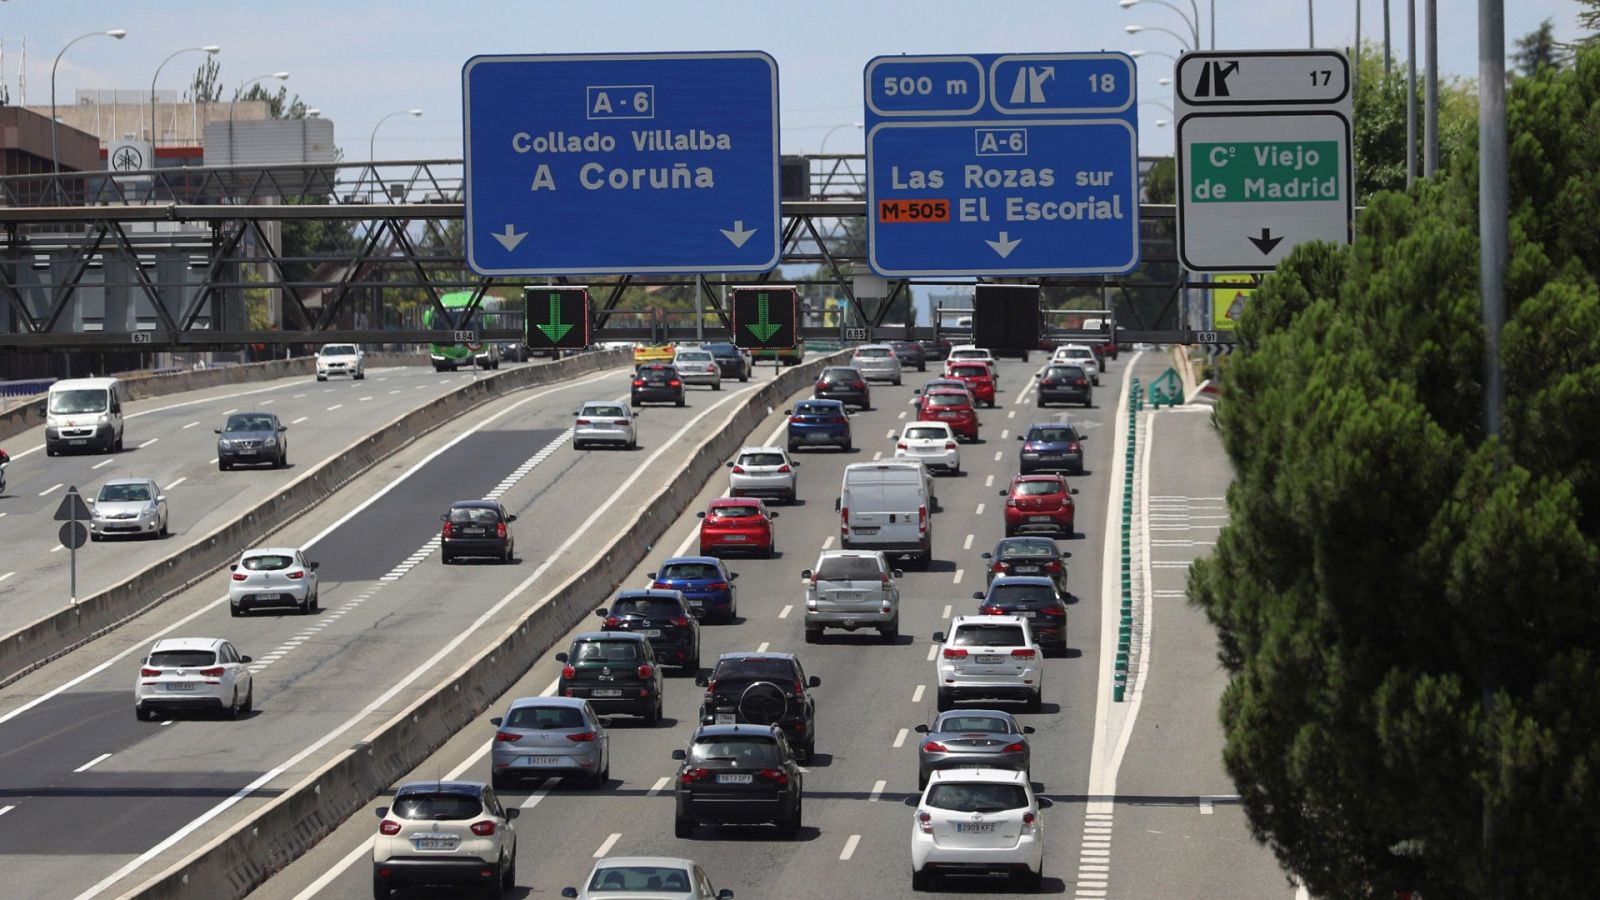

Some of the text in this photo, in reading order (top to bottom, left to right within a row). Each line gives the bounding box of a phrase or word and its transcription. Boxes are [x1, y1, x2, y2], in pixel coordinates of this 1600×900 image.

[884, 76, 968, 96] 500 m
[1088, 73, 1116, 93] 18
[1309, 70, 1332, 87] 17
[511, 129, 732, 154] Collado Villalba
[980, 132, 1024, 152] A-6
[1254, 145, 1320, 171] Viejo
[531, 162, 715, 191] A Coruña
[891, 164, 1114, 190] Las Rozas sur
[1195, 176, 1336, 200] de Madrid
[881, 194, 1124, 222] M-505 El Escorial
